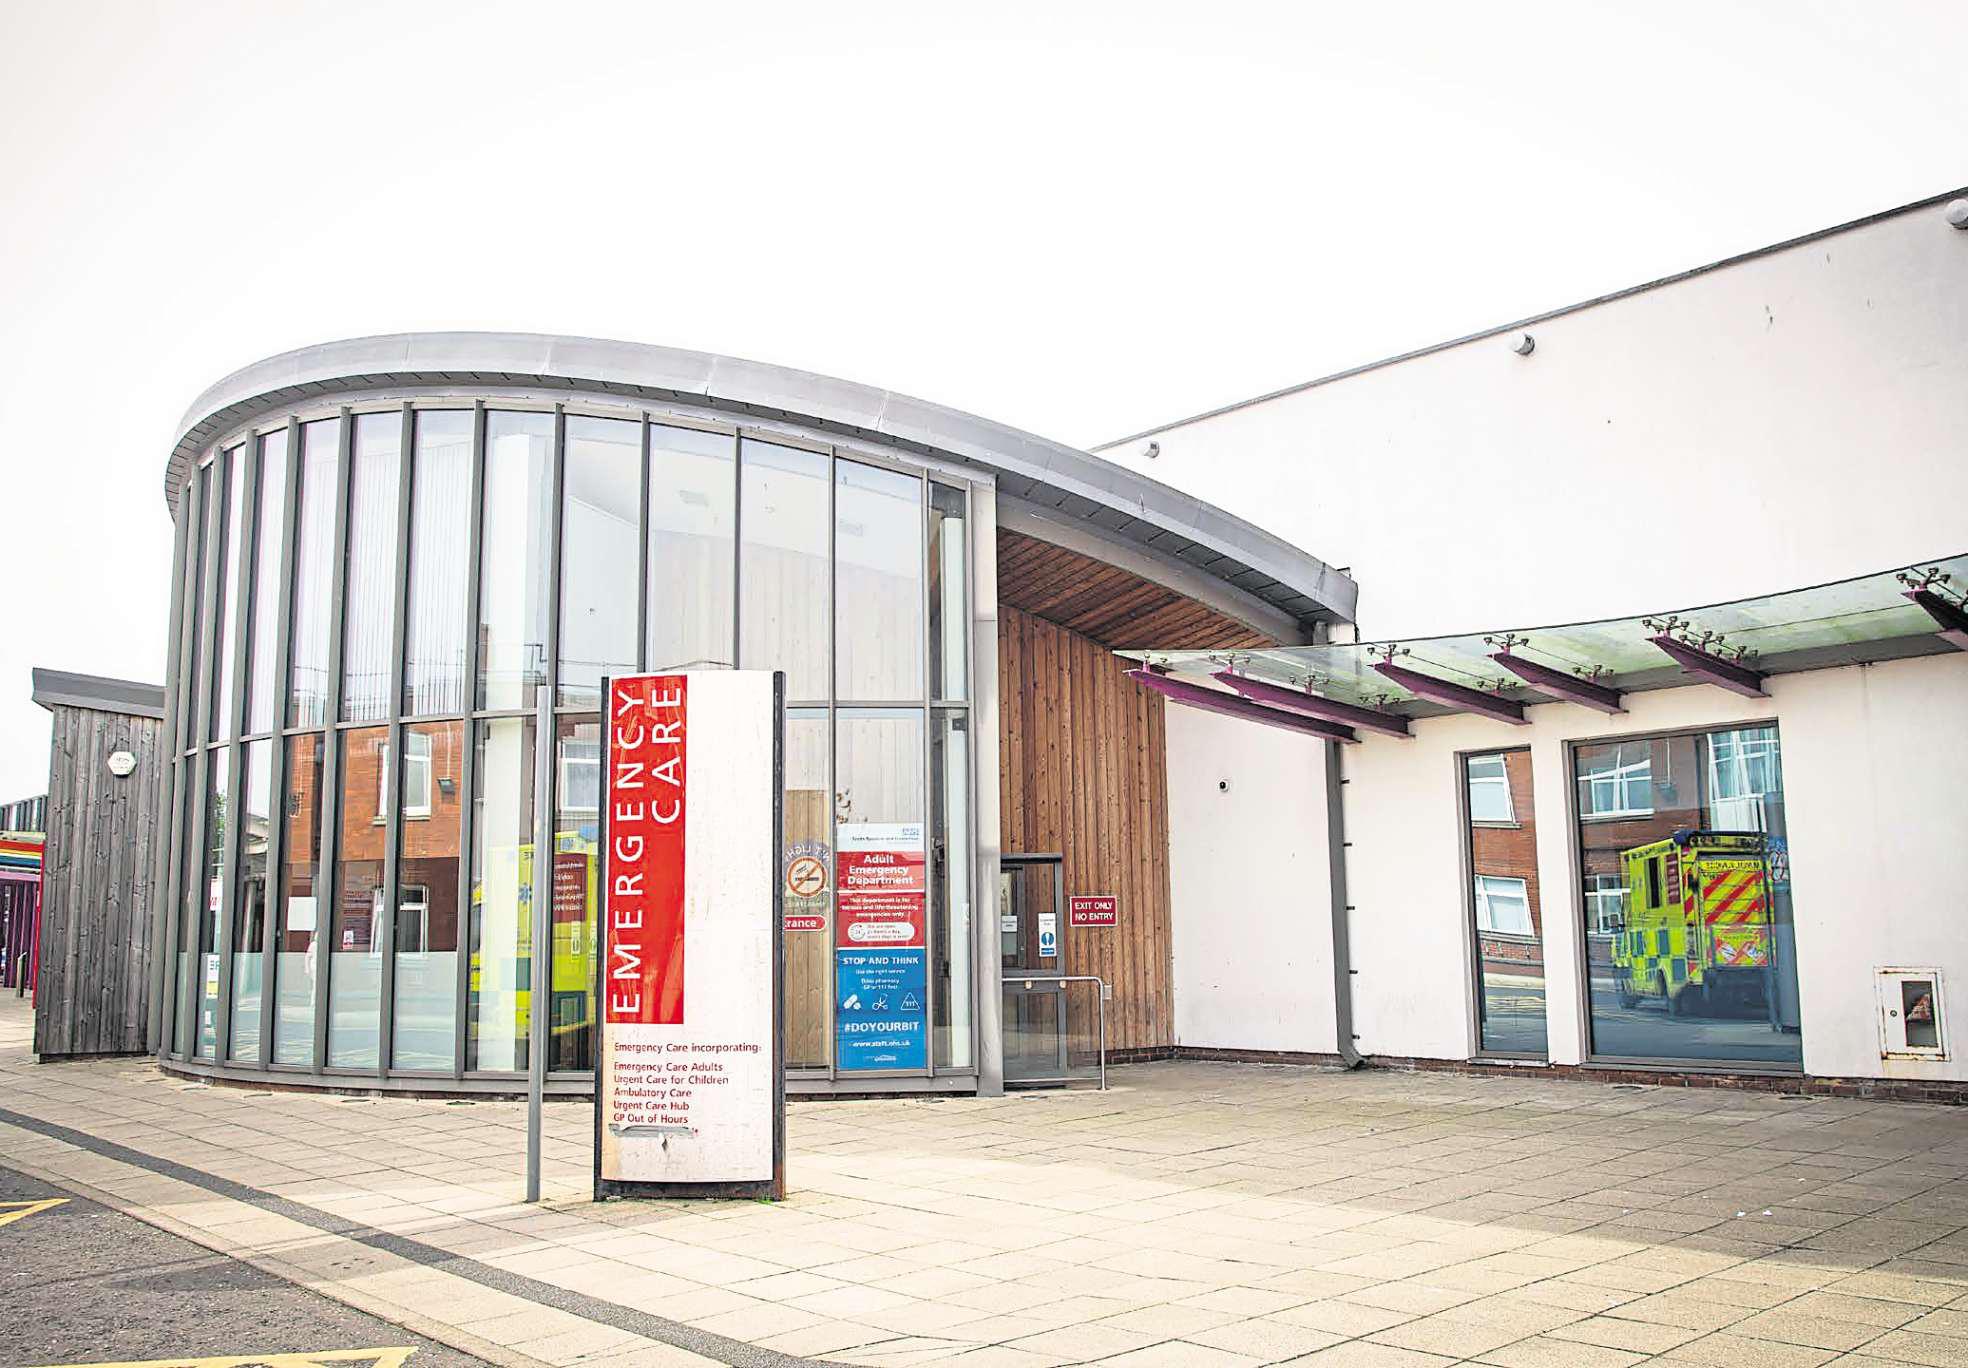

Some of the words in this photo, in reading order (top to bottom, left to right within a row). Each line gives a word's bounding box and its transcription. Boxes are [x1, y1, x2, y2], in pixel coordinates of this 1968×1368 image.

[651, 687, 682, 824] CARE
[613, 690, 644, 1014] EMERGENCY
[863, 854, 894, 864] Adult
[849, 865, 909, 876] Emergency
[847, 876, 913, 887] Department
[1074, 901, 1092, 910] EXIT
[1094, 901, 1112, 910] ONLY
[1075, 913, 1087, 921] NO
[1089, 912, 1113, 921] ENTRY
[843, 957, 866, 965] STOP
[868, 957, 889, 965] AND
[891, 957, 919, 965] THINK
[844, 1021, 920, 1032] #DOYOURBIT
[614, 1042, 663, 1054] Emergency
[666, 1043, 688, 1052] Care
[691, 1042, 762, 1054] incorporating:
[614, 1062, 662, 1073] Emergency
[666, 1062, 688, 1072] Care
[691, 1062, 723, 1072] Adults
[614, 1075, 643, 1085] Urgent
[646, 1075, 667, 1084] Care
[670, 1075, 685, 1084] for
[688, 1075, 729, 1085] Children
[614, 1087, 666, 1099] Ambulatory
[669, 1088, 692, 1097] Care
[613, 1100, 642, 1111] Urgent
[645, 1101, 667, 1110] Care
[670, 1101, 690, 1111] Hub
[613, 1113, 625, 1122] GP
[627, 1113, 644, 1123] Out
[647, 1113, 657, 1123] of
[660, 1113, 689, 1124] Hours
